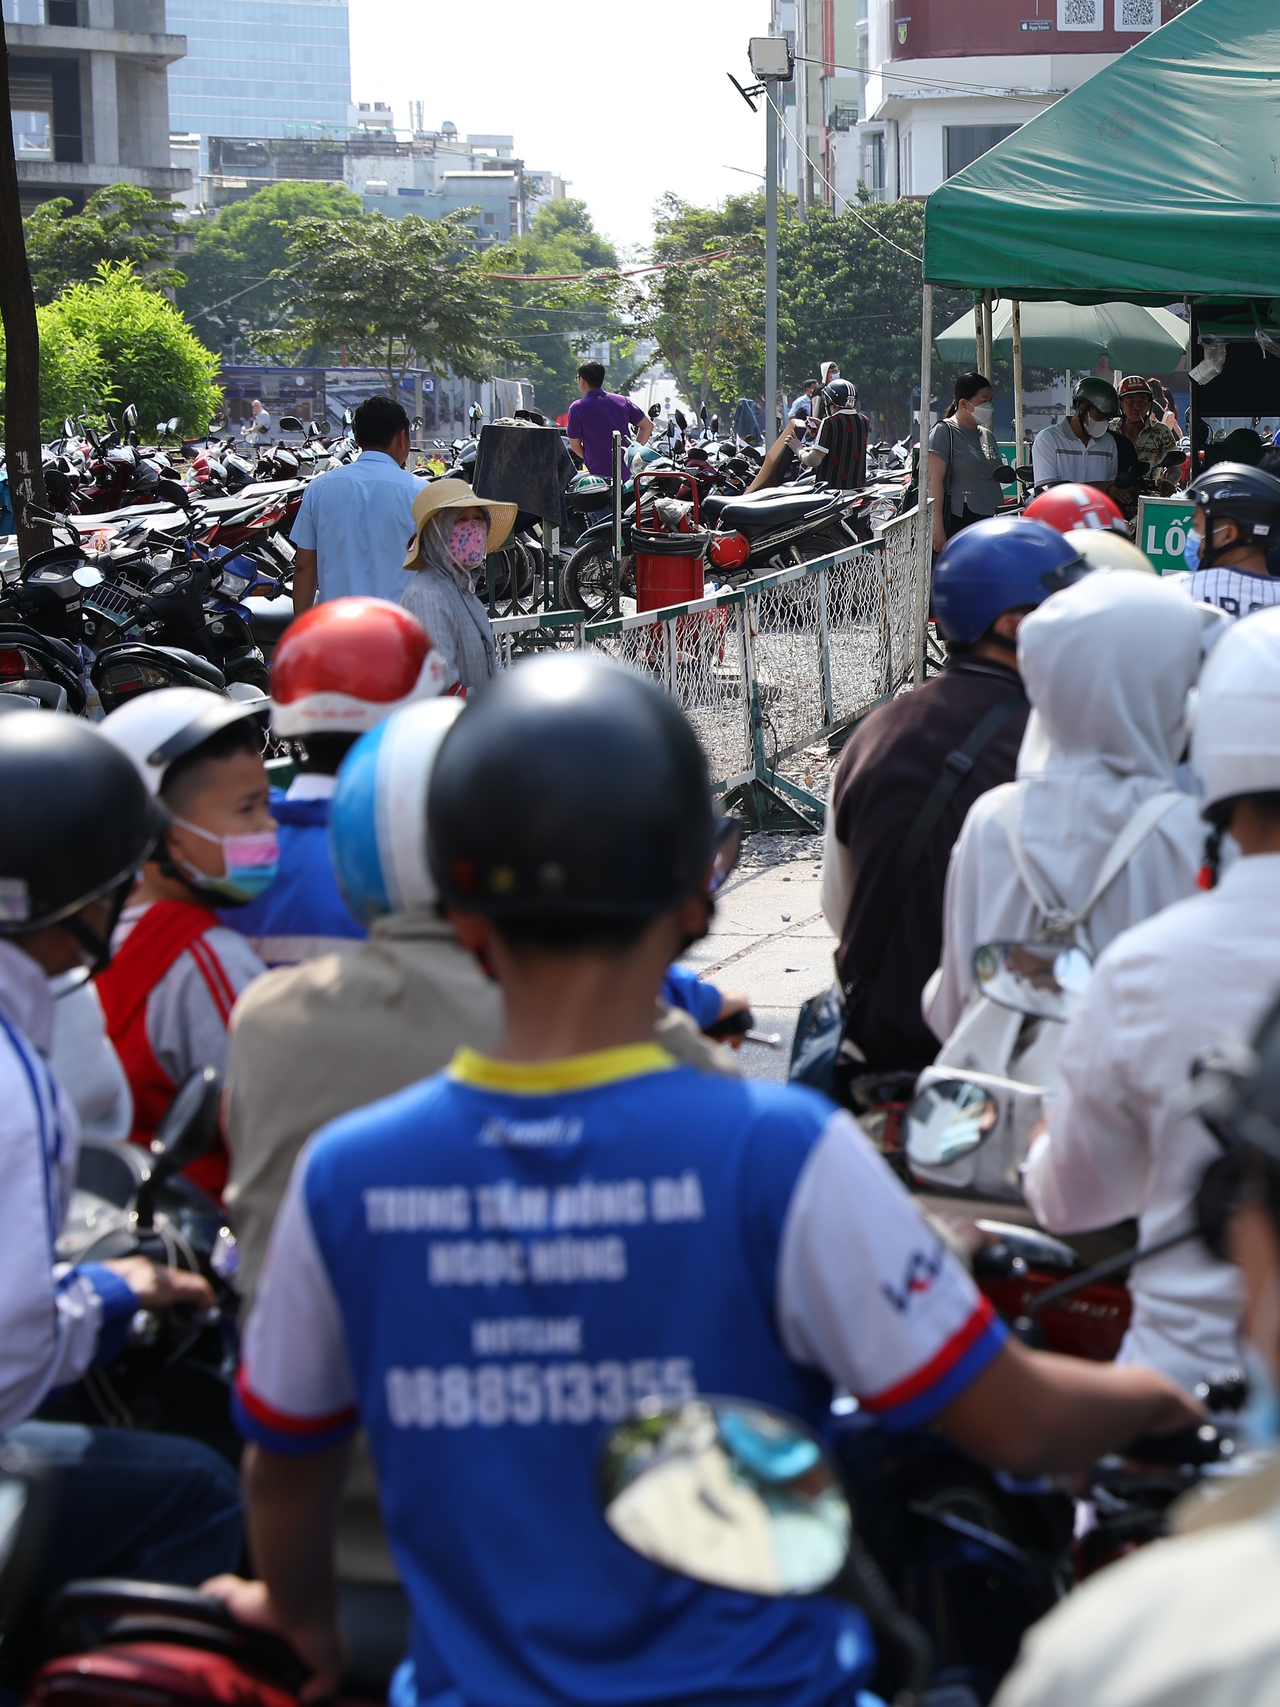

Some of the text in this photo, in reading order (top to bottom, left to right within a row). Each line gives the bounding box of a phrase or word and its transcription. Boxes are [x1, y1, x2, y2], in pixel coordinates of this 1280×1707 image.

[363, 1186, 471, 1232] TRUNG
[476, 1178, 549, 1230] TÂM
[472, 1316, 583, 1356] HOTLINE
